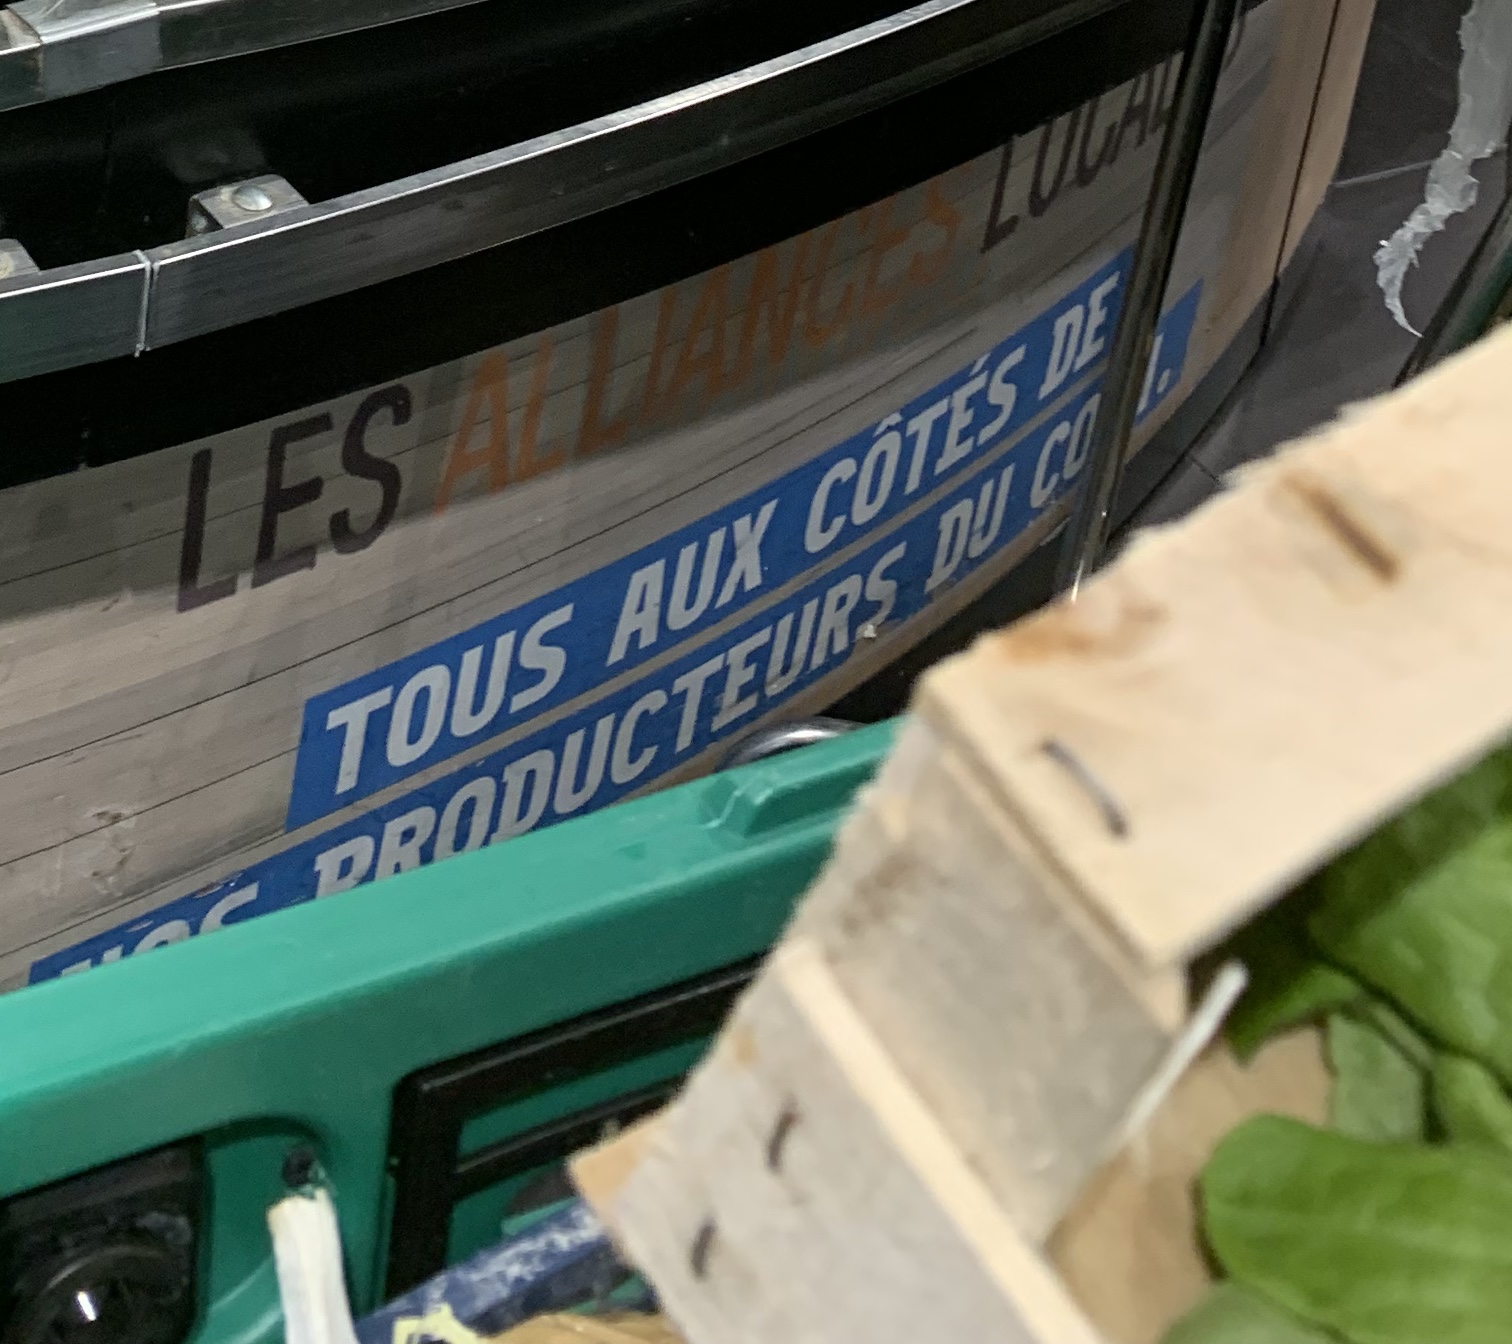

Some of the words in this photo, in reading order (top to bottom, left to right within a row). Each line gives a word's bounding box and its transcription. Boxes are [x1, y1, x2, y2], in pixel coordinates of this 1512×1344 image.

[178, 384, 413, 614] LES
[432, 155, 975, 515] ALLIANCES
[311, 541, 907, 901] PRODUCTEURS
[923, 463, 1016, 595] DU
[1030, 333, 1172, 511] CO.
[326, 603, 575, 795] TOUS
[606, 498, 780, 667] AUX
[802, 345, 1028, 554] CÔTÉS
[1039, 270, 1121, 401] DE
